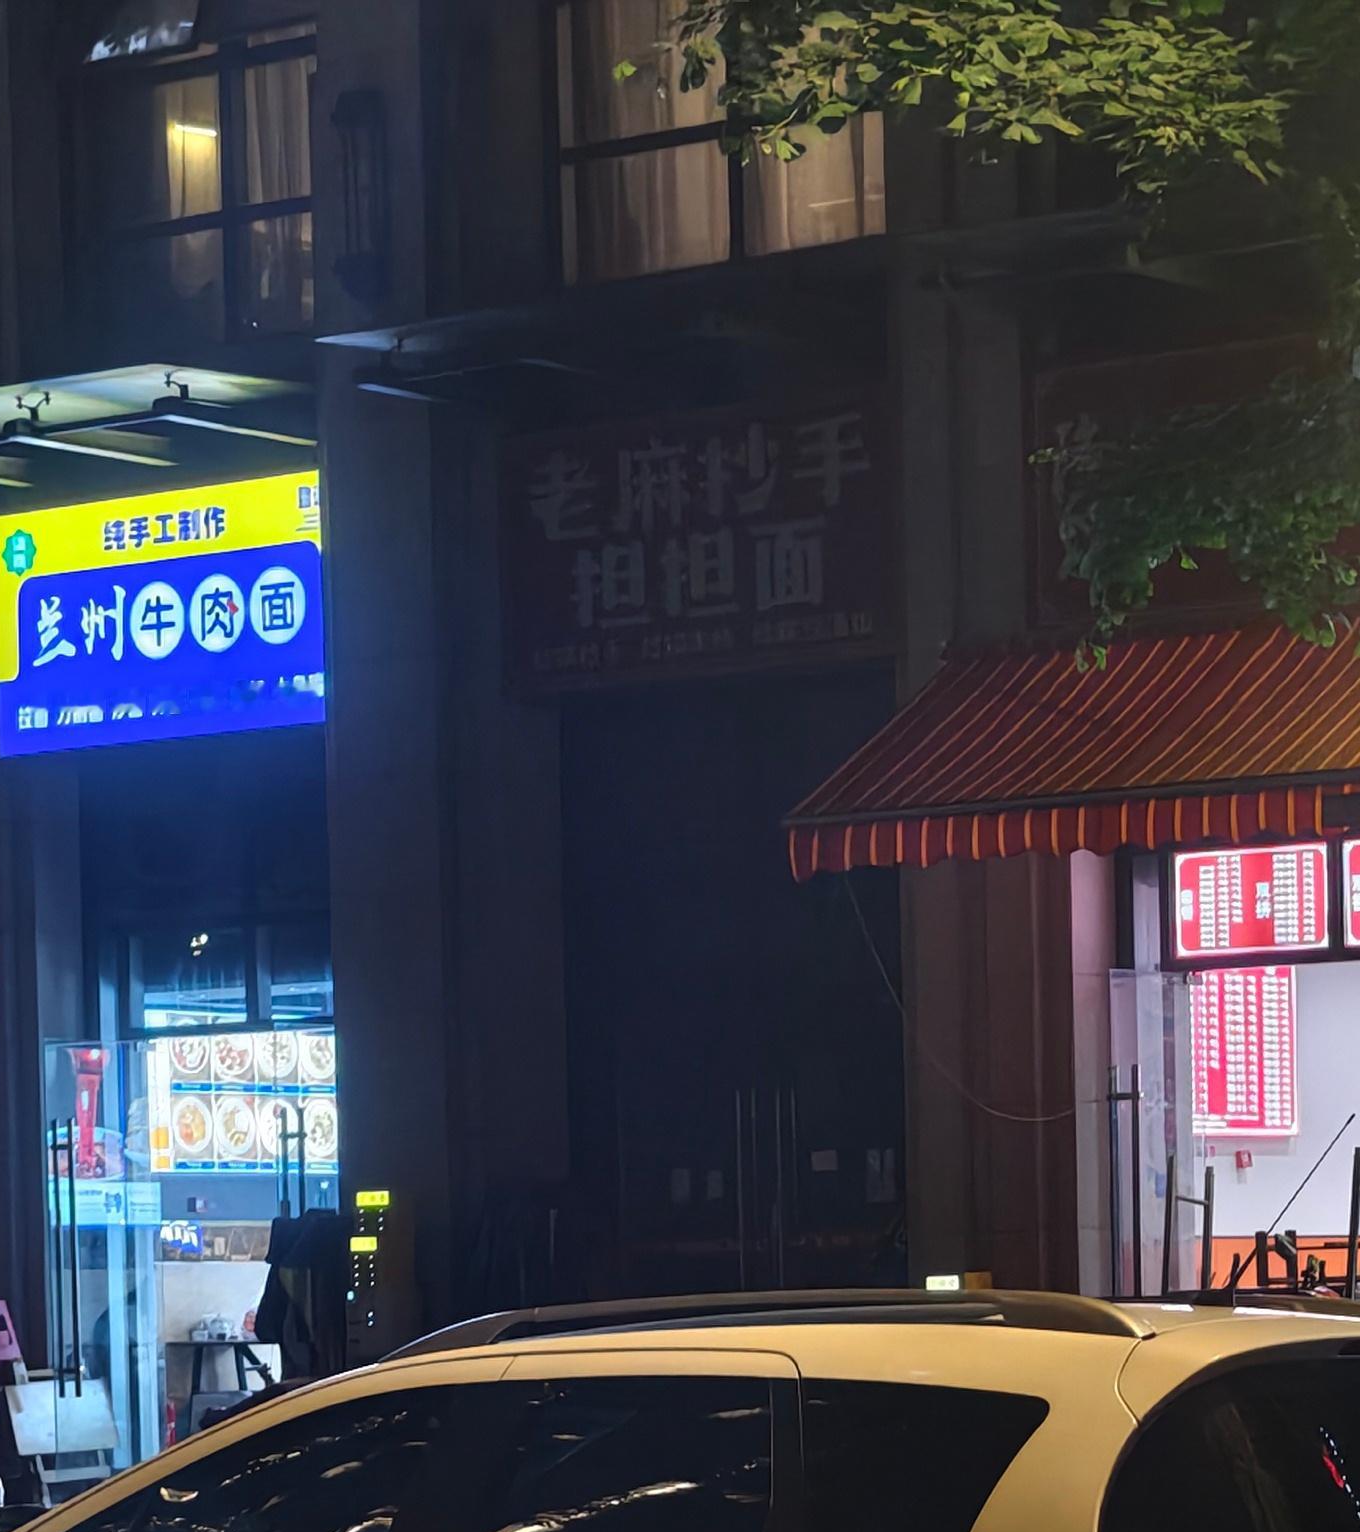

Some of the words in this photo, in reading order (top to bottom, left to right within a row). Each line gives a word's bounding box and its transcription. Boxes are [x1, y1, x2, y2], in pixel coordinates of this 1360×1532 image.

[527, 410, 871, 542] 老麻抄手
[102, 506, 227, 552] 纯手工制作
[569, 514, 828, 629] 担担面
[31, 578, 298, 668] 兰州牛肉面
